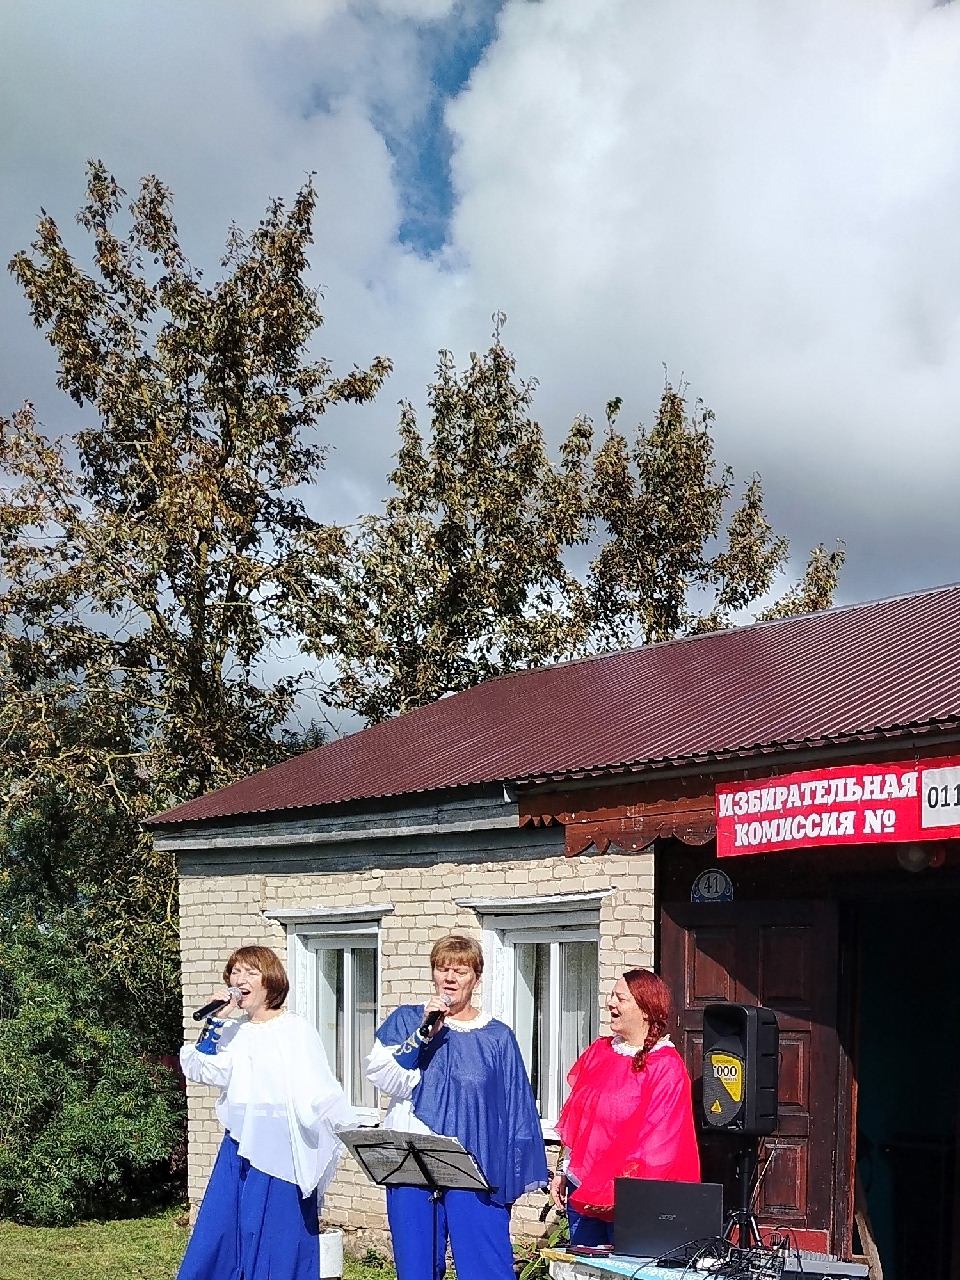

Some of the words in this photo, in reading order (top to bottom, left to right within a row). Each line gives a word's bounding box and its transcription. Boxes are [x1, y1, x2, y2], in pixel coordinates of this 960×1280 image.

[718, 771, 919, 818] ИЗБИРАТЕЛЬНАЯ
[733, 810, 857, 848] КОМИССИЯ
[703, 875, 720, 894] 41
